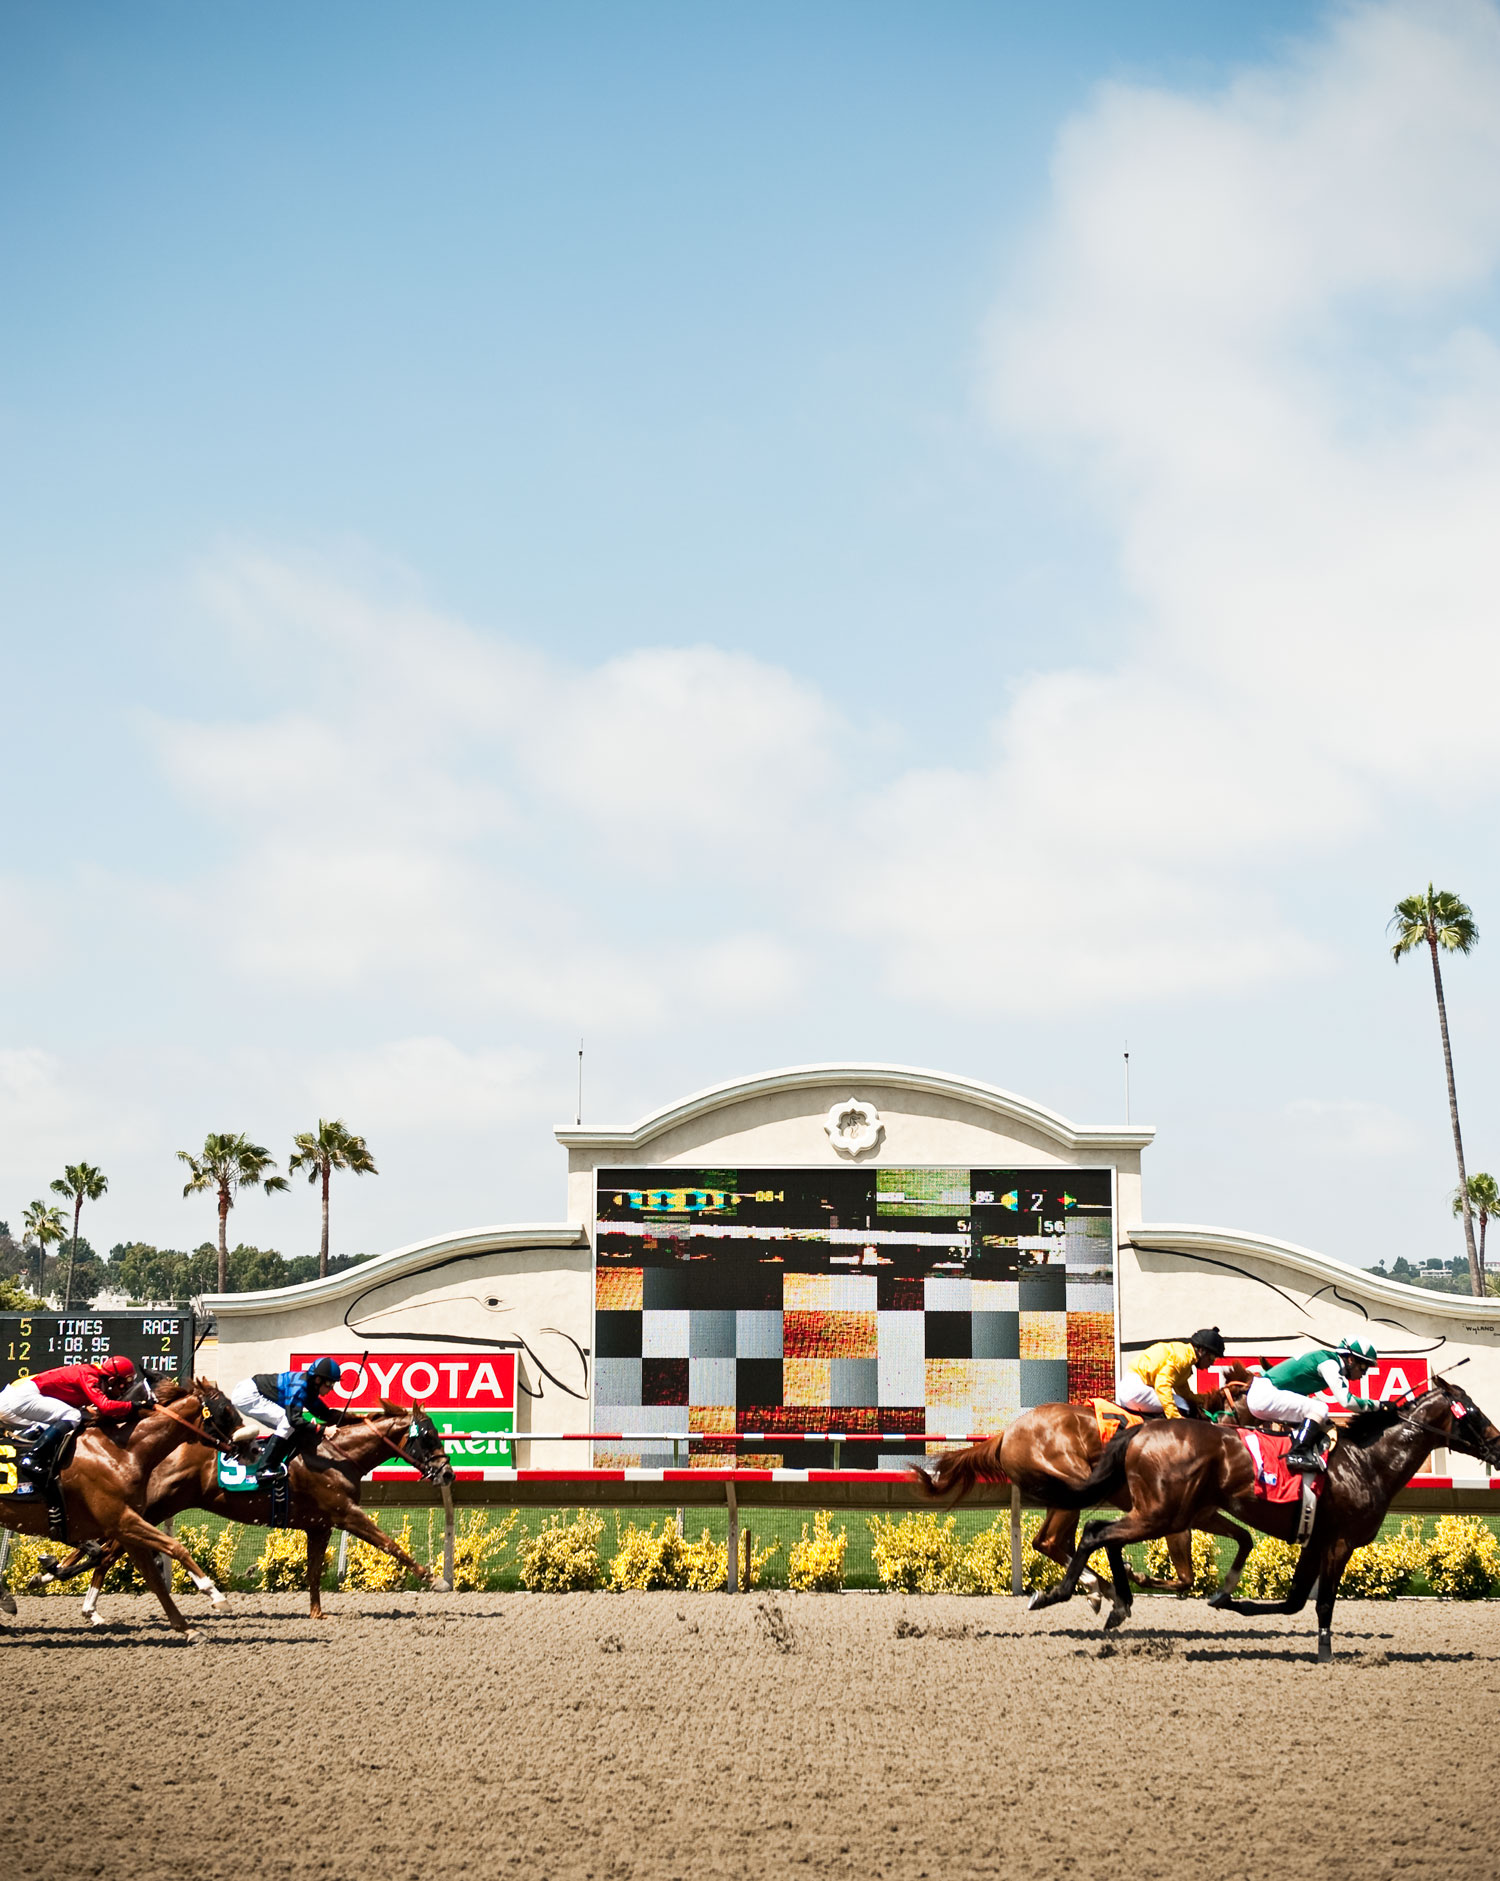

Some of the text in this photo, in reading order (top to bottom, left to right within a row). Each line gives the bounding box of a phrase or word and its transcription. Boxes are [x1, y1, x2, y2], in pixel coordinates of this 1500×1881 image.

[1030, 1193, 1044, 1212] 2
[20, 1317, 32, 1337] 5
[57, 1319, 103, 1336] TIMES
[142, 1319, 180, 1335] RACE
[7, 1341, 31, 1361] 12
[48, 1336, 111, 1352] 1:08.95
[160, 1336, 171, 1352] 2
[141, 1355, 178, 1371] TIME
[201, 1406, 211, 1419] 6
